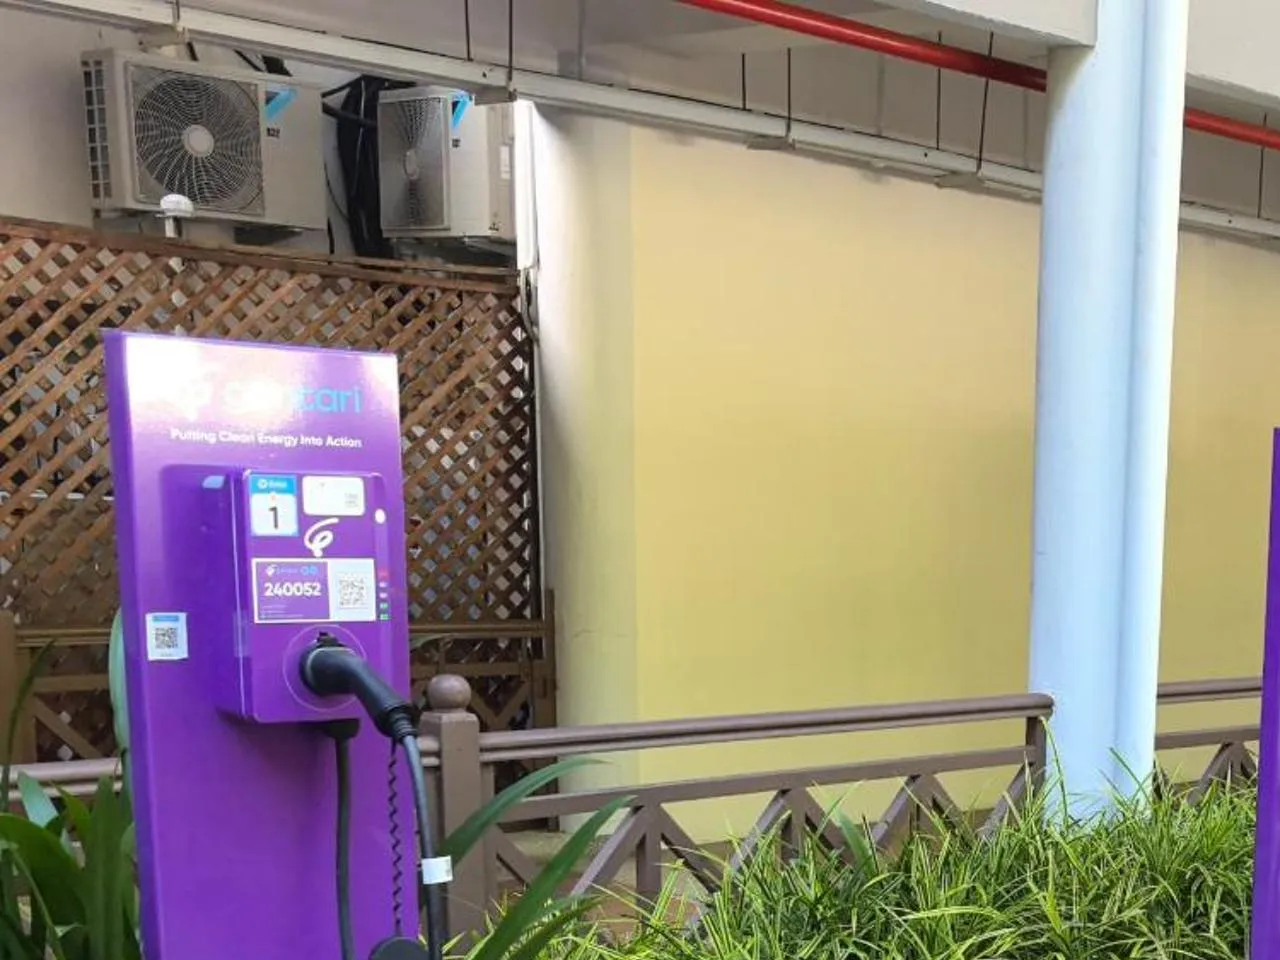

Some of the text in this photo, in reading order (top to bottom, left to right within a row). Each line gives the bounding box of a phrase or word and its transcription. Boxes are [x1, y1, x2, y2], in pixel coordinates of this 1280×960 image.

[170, 428, 362, 448] Putting Clean Energy Into Action
[268, 506, 279, 529] 1
[264, 582, 321, 597] 240052
